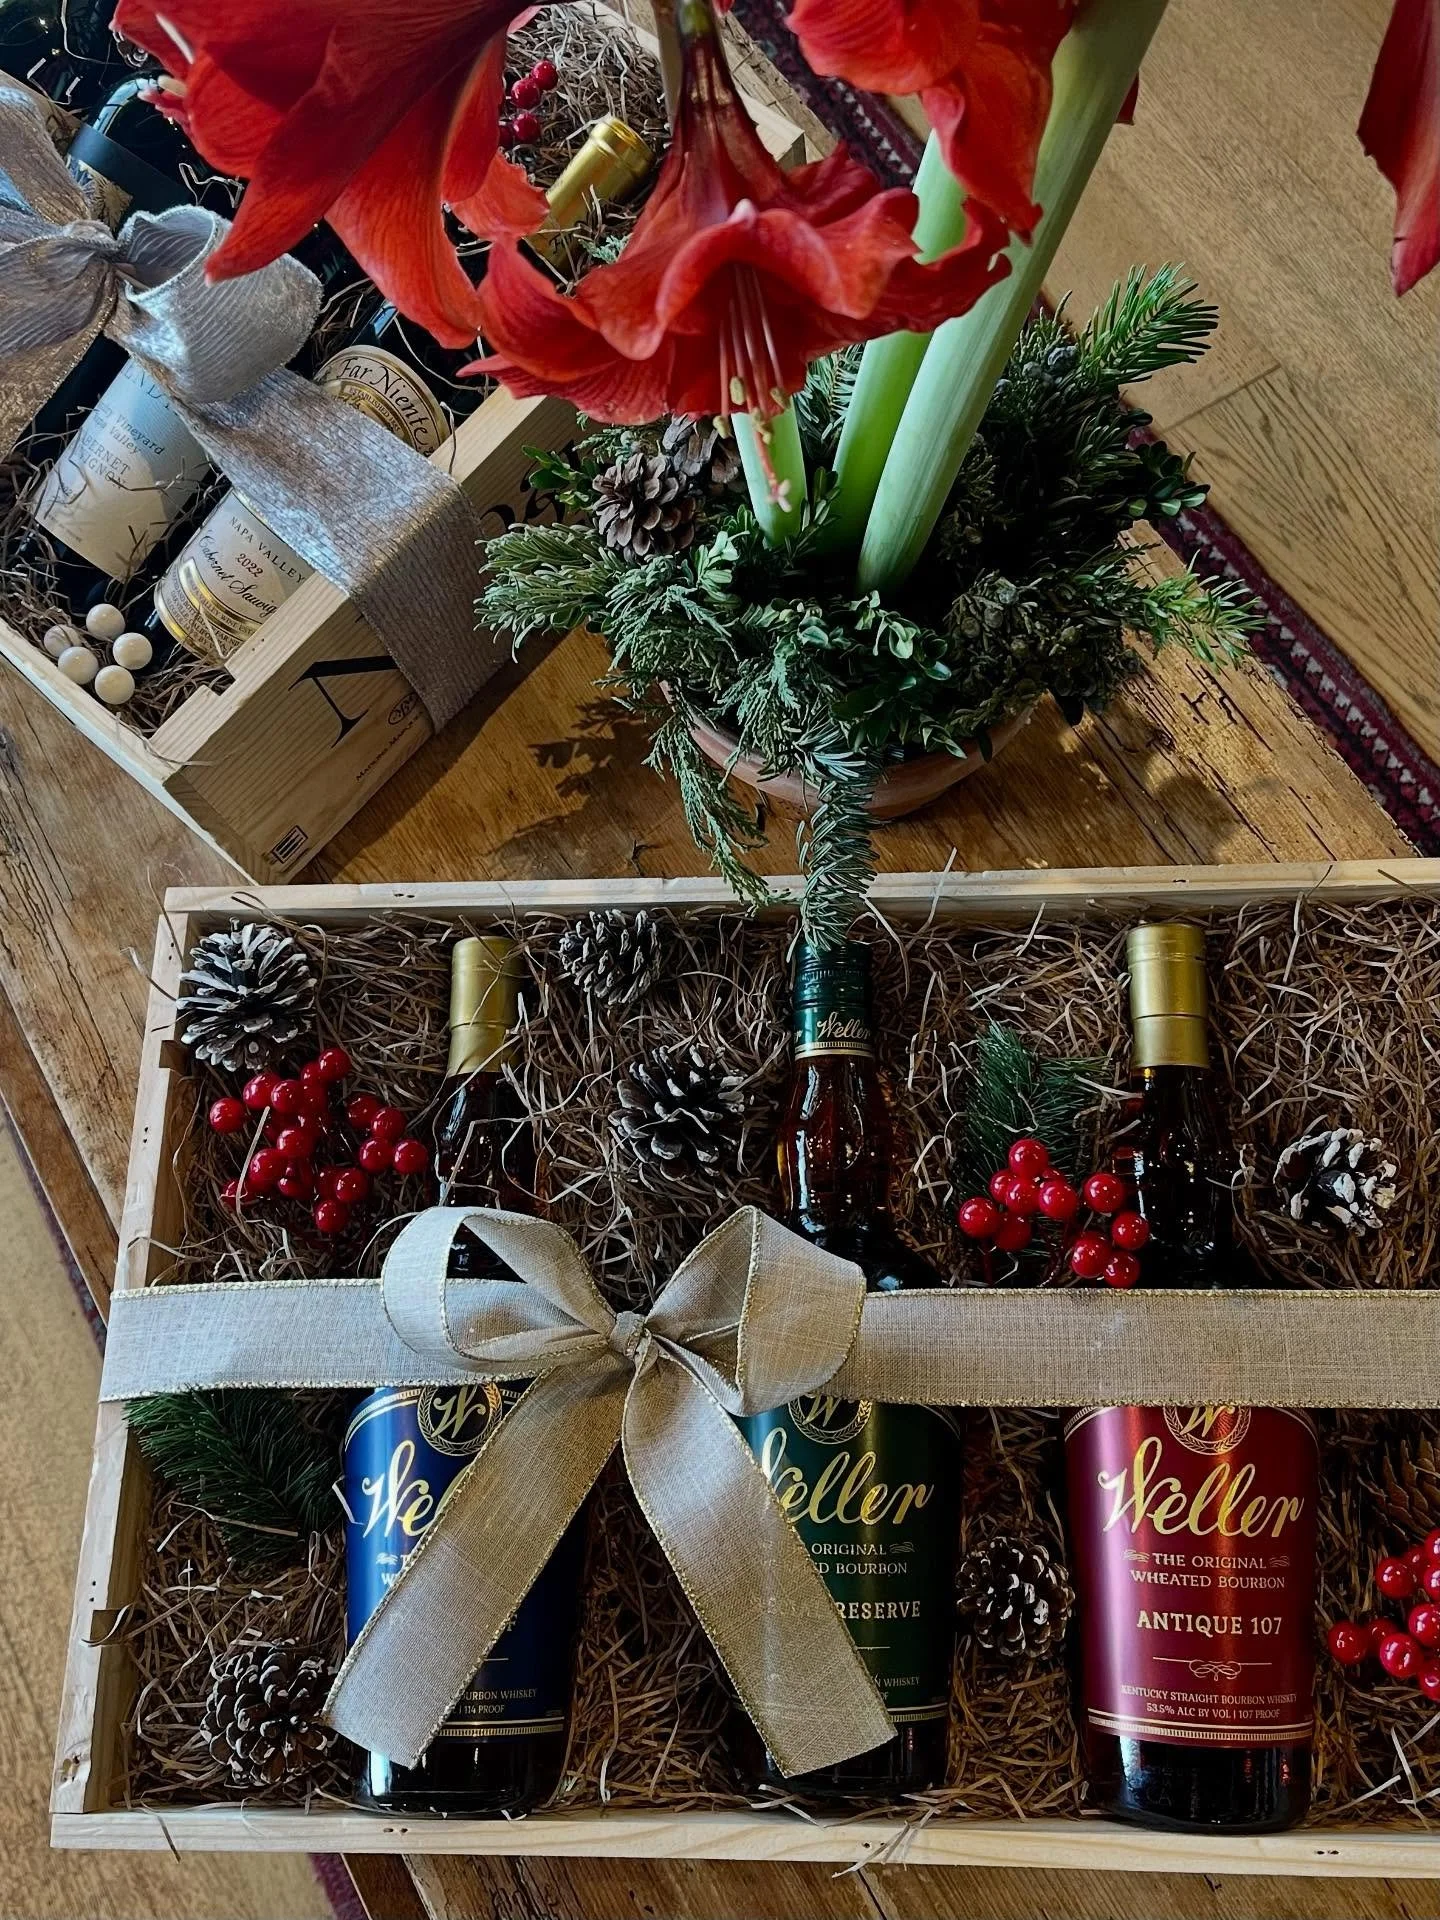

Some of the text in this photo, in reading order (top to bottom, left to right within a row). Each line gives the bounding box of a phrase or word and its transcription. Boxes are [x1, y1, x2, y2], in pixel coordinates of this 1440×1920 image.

[336, 357, 430, 446] Far Niente
[349, 386, 390, 418] ESTABLISHED
[108, 424, 141, 454] Valley
[117, 415, 165, 455] Vineyard
[229, 516, 306, 584] NAPA VALLEY
[198, 529, 279, 618] Cabernet Sauvig
[234, 553, 263, 578] 2022
[816, 1011, 871, 1040] Weller
[1097, 1436, 1305, 1538] Weller
[811, 1543, 887, 1556] ORIGINAL
[1152, 1552, 1267, 1569] THE ORIGINAL
[835, 1562, 908, 1575] BOURBON
[1130, 1569, 1285, 1589] WHEATED BOURBON
[836, 1600, 921, 1620] RESERVE
[1136, 1610, 1282, 1638] ANTIQUE 107
[883, 1676, 920, 1688] WHISKEY
[500, 1687, 539, 1700] WHISKEY
[1120, 1685, 1168, 1700] KENTUCKY
[1170, 1691, 1218, 1705] STRAIGHT
[1221, 1693, 1265, 1705] BOURBON
[464, 1705, 476, 1715] 114
[478, 1704, 505, 1714] PROOF
[1146, 1703, 1280, 1719] 53.5% ALC BY VOL 107 PROOF
